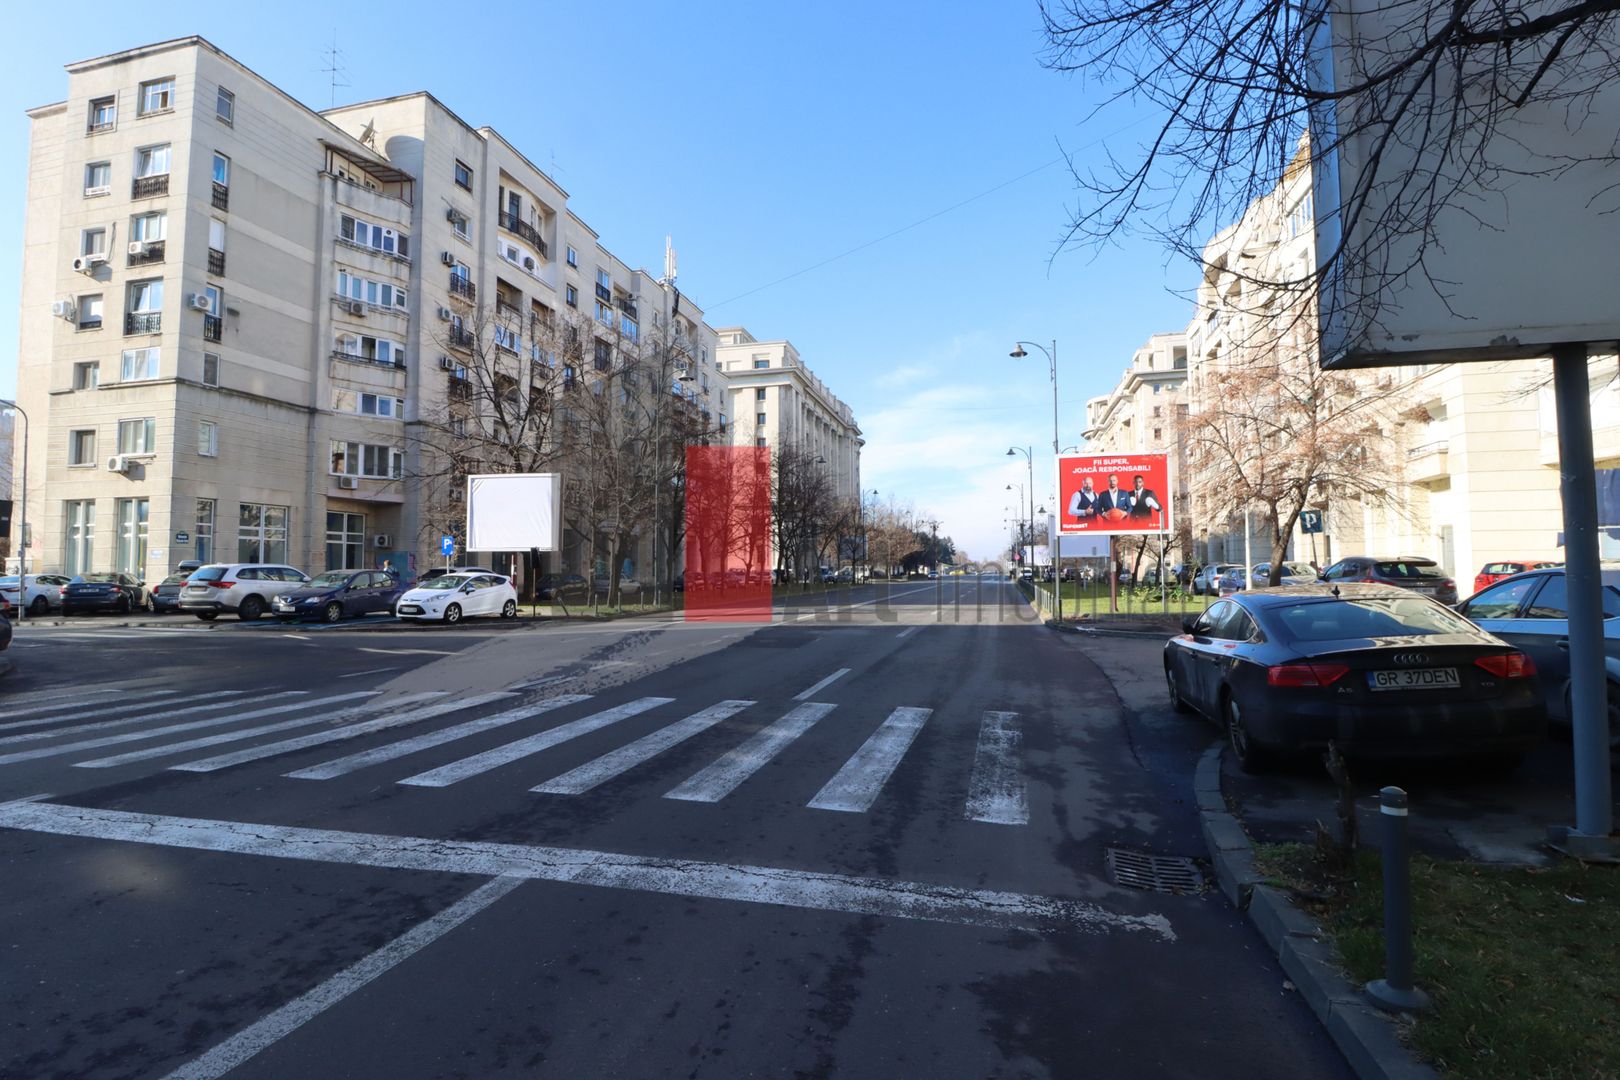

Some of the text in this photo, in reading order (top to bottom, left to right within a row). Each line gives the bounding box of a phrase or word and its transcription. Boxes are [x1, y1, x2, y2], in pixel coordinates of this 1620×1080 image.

[1098, 465, 1151, 473] RESPONSABIL!
[1376, 669, 1457, 687] GR 37DEN
